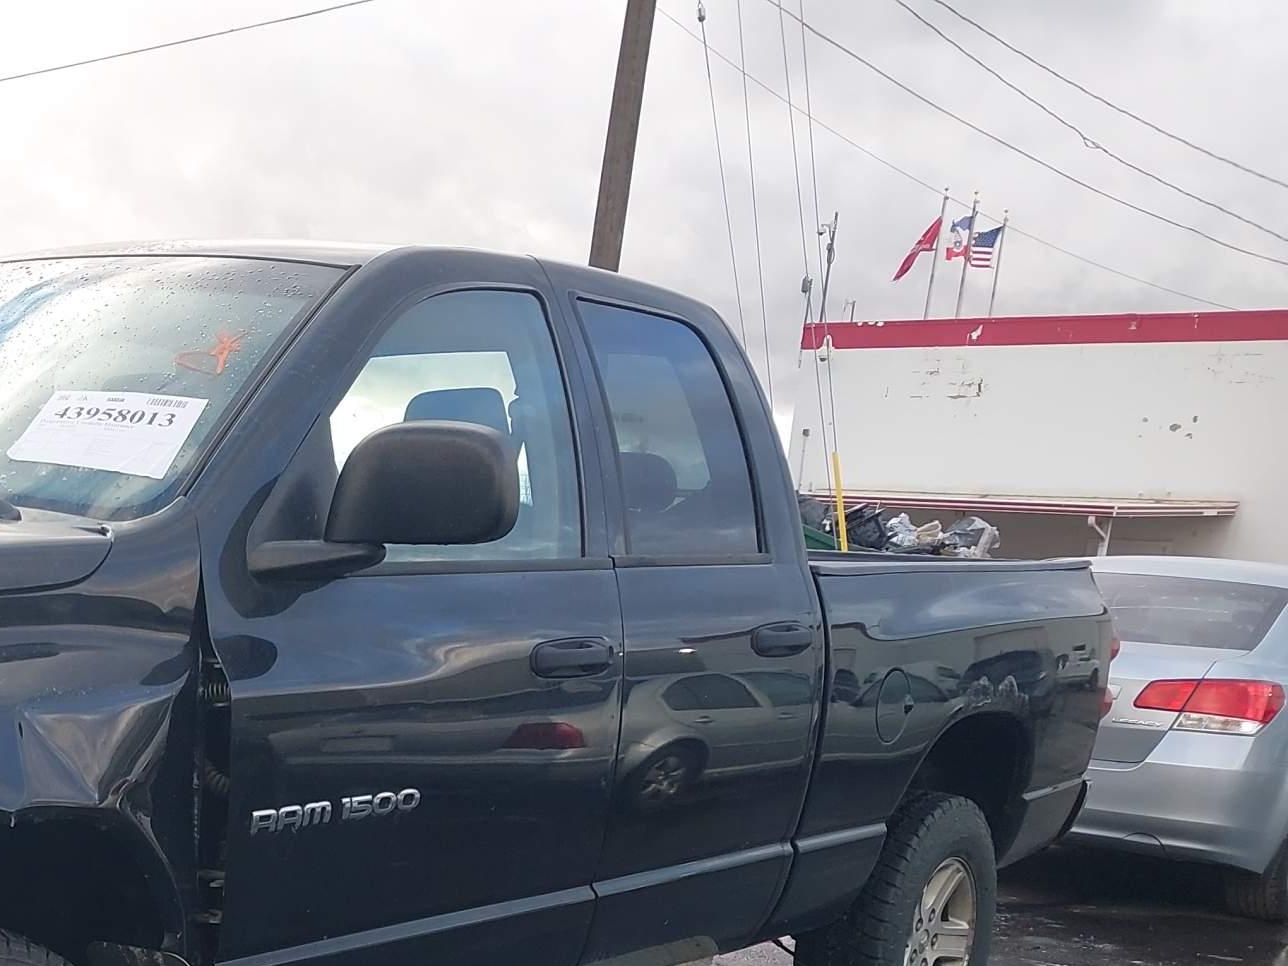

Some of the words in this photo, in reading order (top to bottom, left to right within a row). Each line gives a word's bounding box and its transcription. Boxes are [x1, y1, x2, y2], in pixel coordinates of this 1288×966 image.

[54, 405, 177, 428] 43958013
[1111, 717, 1161, 728] LEGACY
[249, 800, 333, 835] RAM
[340, 788, 421, 820] 1500
